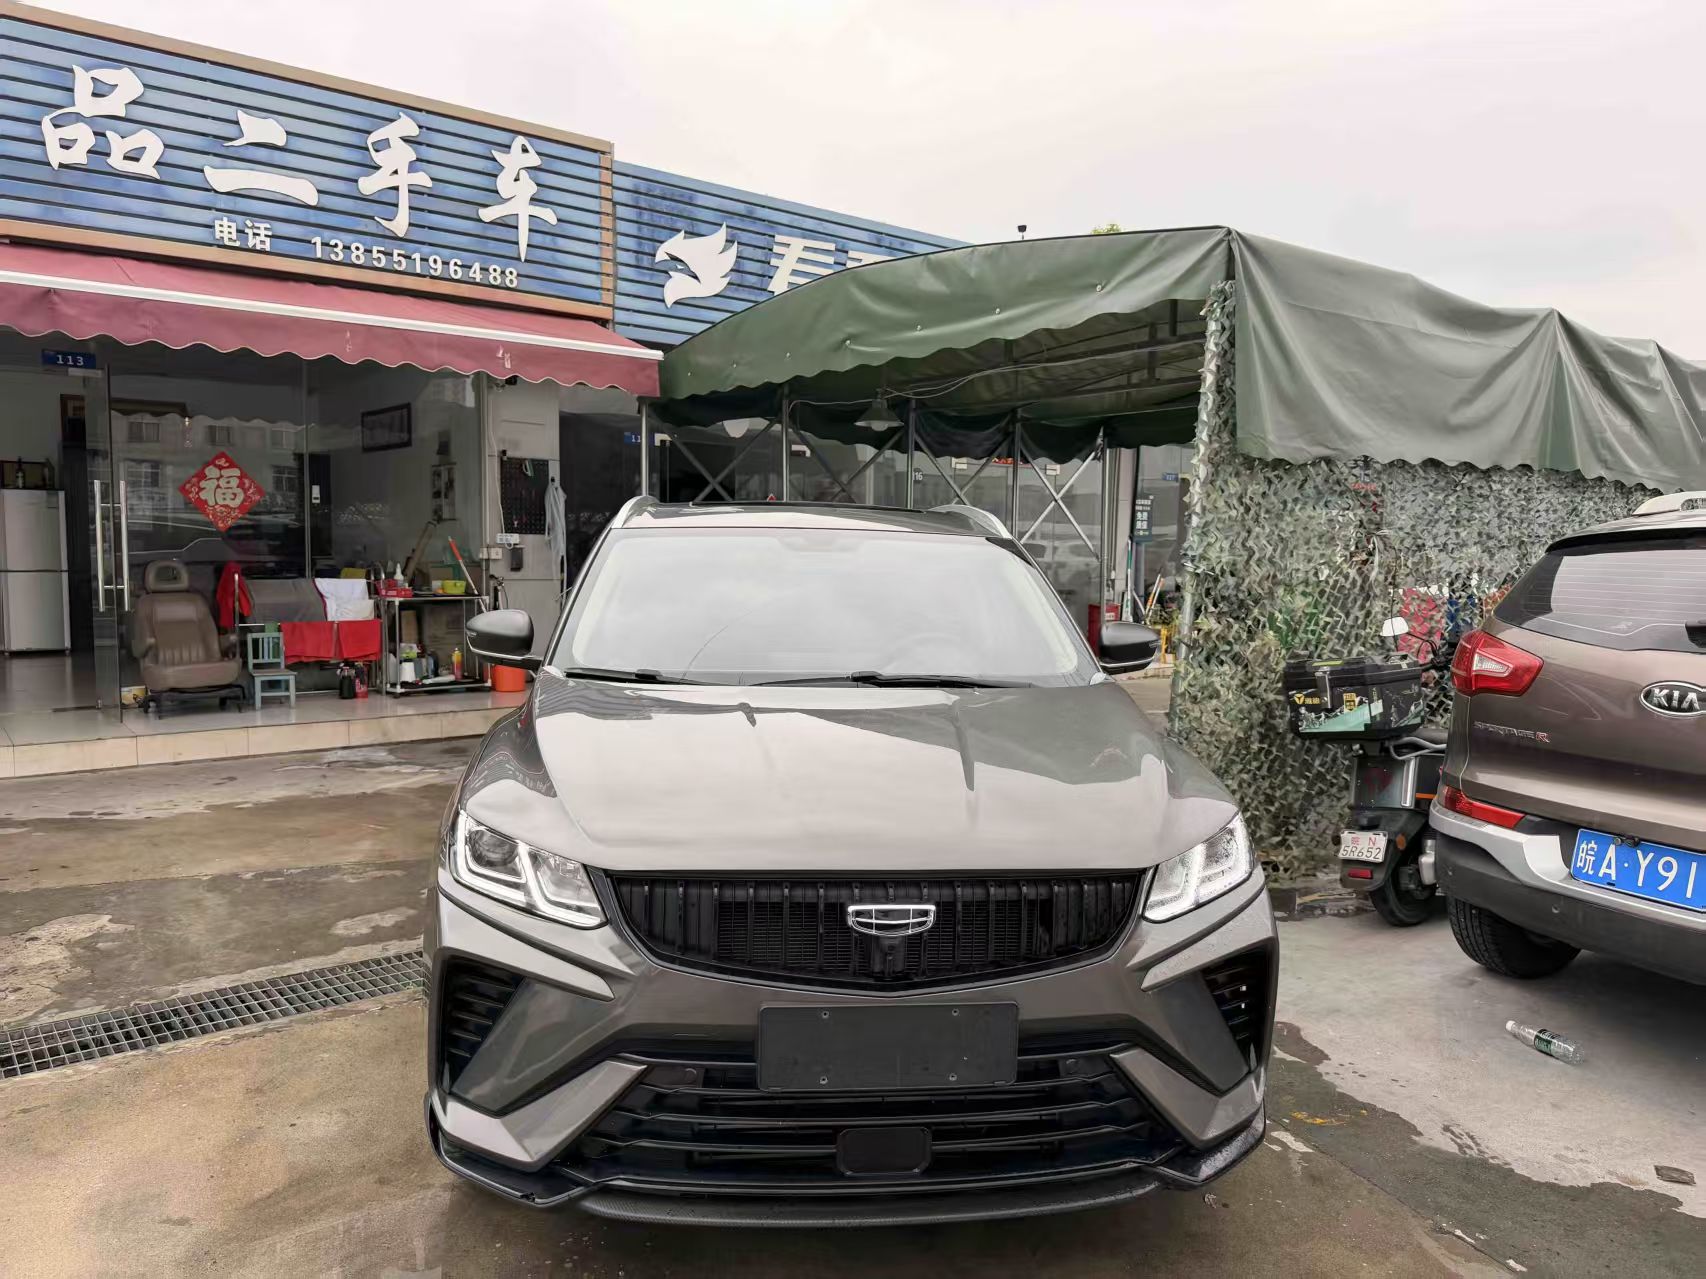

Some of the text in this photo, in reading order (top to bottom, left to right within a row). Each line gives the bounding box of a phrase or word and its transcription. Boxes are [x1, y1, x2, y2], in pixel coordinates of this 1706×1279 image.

[41, 65, 557, 262] 品二手车
[213, 217, 519, 289] 电话 13855196488
[57, 354, 84, 366] 113
[199, 465, 244, 508] 福
[1652, 687, 1700, 710] KIA
[1341, 845, 1382, 860] 5R652
[1368, 836, 1377, 846] N
